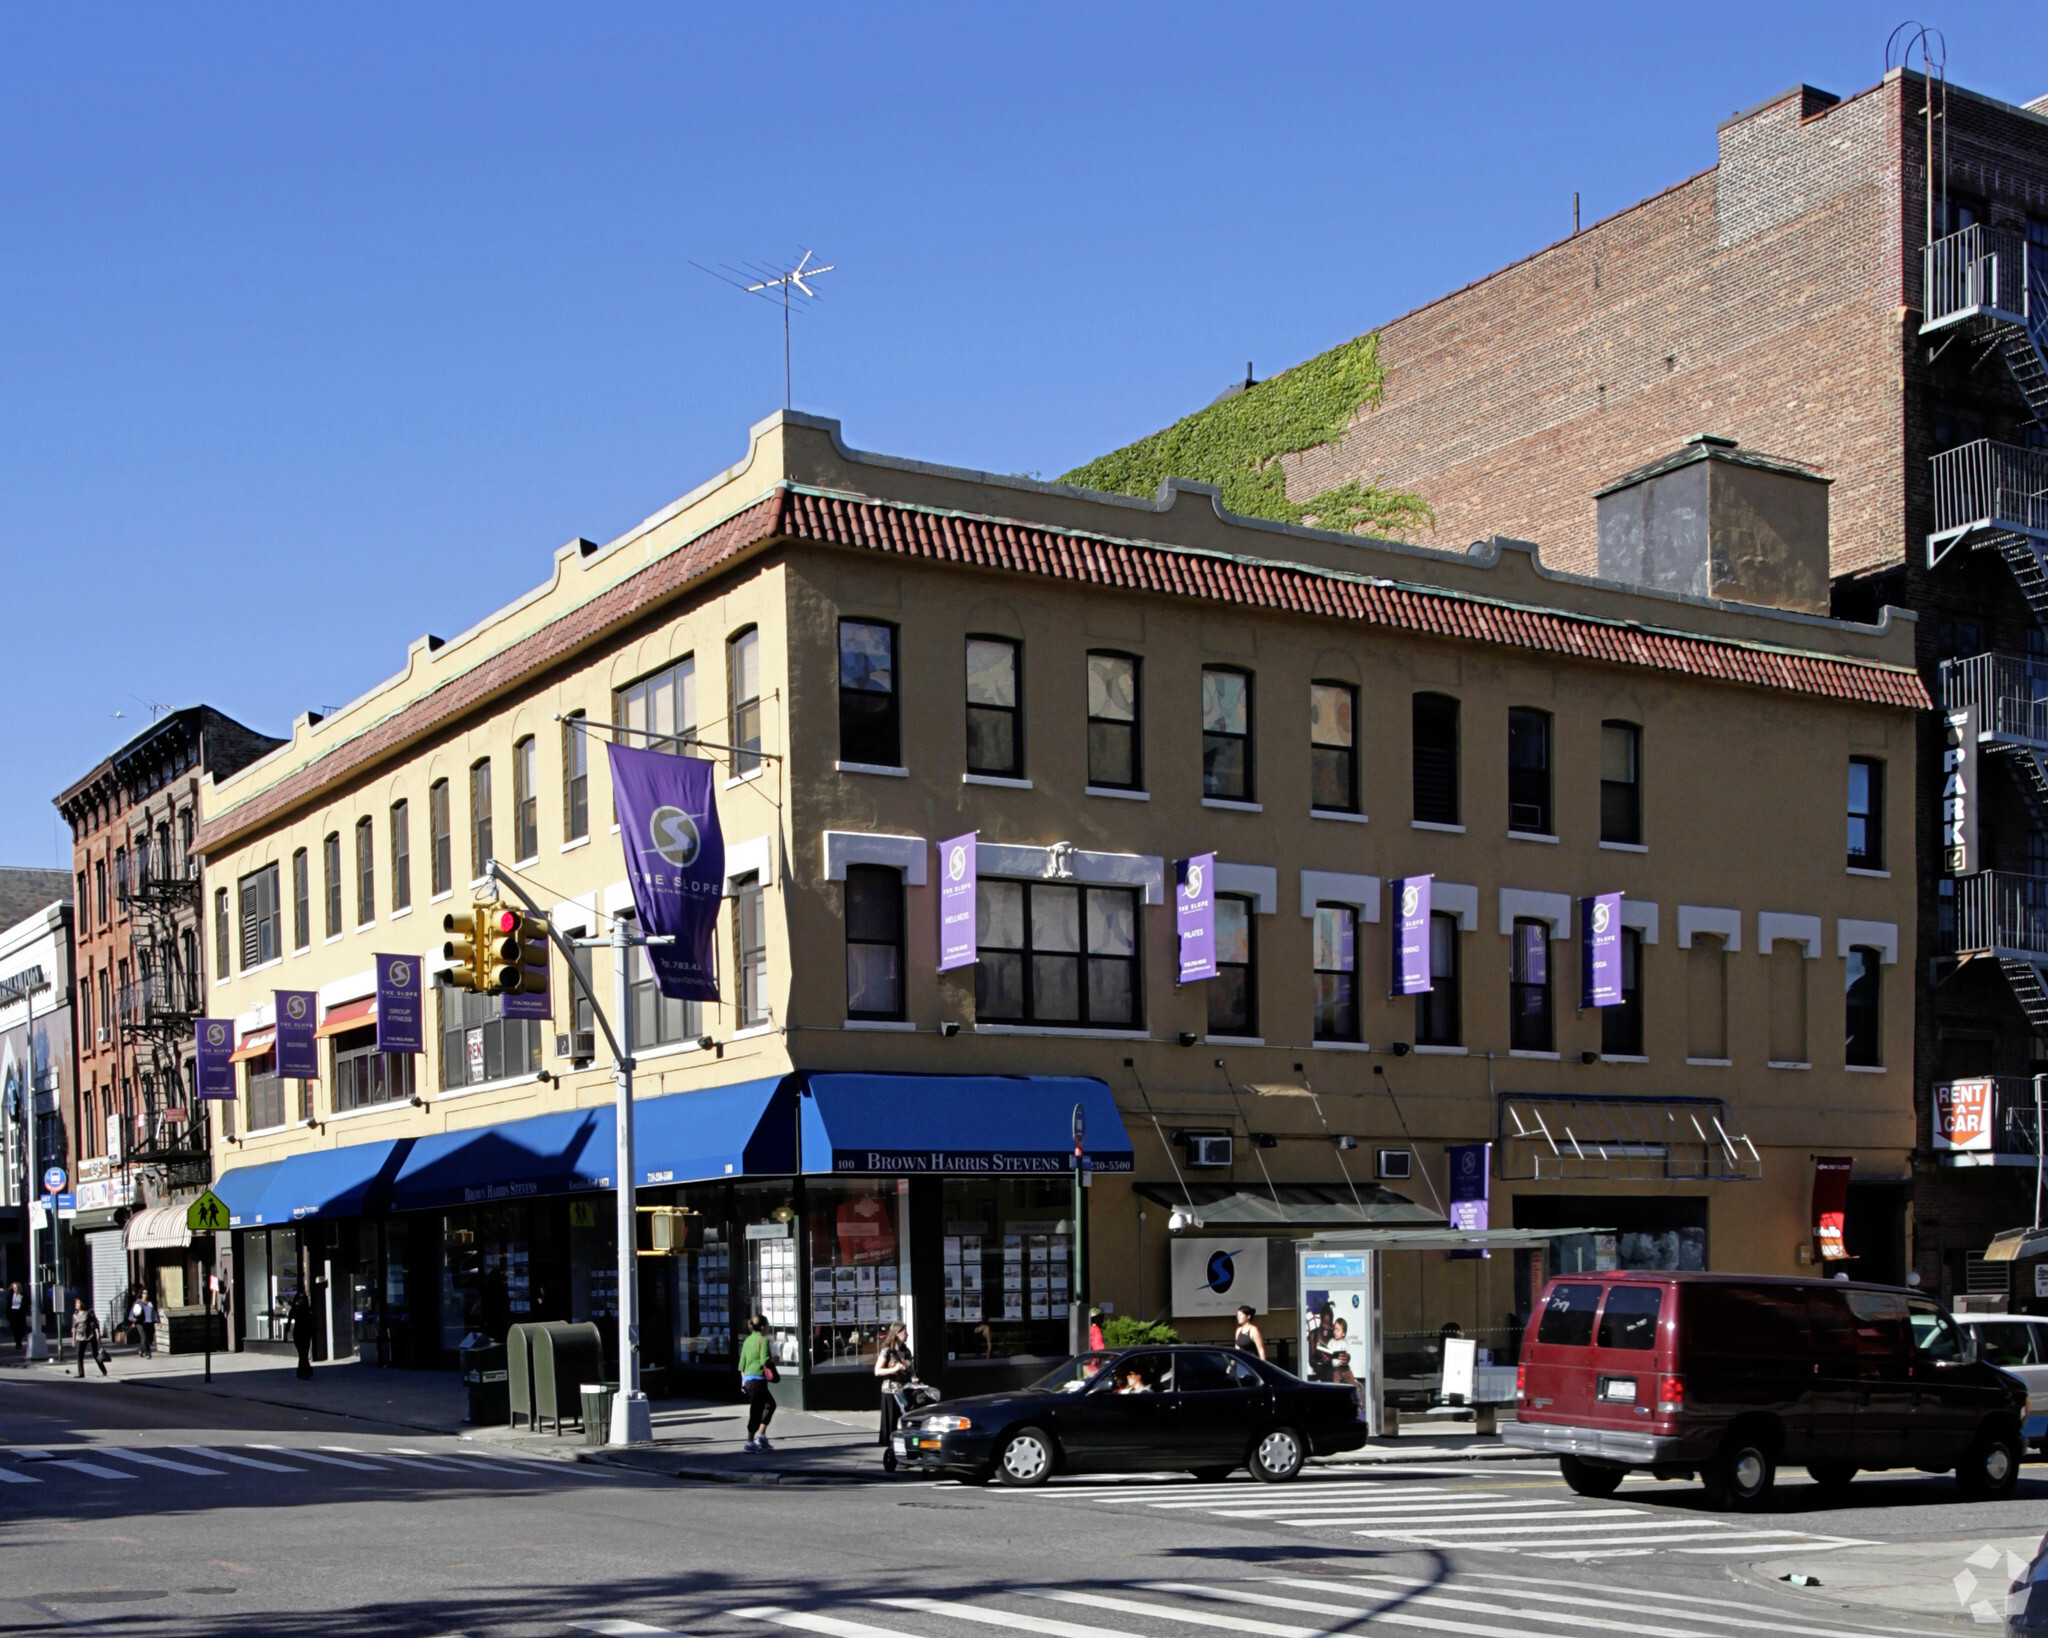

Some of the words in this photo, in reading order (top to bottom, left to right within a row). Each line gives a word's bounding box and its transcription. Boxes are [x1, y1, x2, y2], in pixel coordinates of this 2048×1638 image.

[1942, 747, 1967, 847] PARK
[674, 876, 719, 895] SLOPE
[945, 911, 970, 924] WELLNESS
[1183, 928, 1204, 939] PILATES
[387, 1015, 413, 1023] FITNESS
[467, 1042, 483, 1060] REN
[1939, 1085, 1983, 1104] RENT
[1944, 1115, 1979, 1132] CAR
[837, 1159, 855, 1170] 100
[866, 1152, 927, 1171] BROWN
[931, 1153, 989, 1171] HARRIS
[992, 1153, 1059, 1172] STEVENS
[1091, 1160, 1131, 1171] 230-5500
